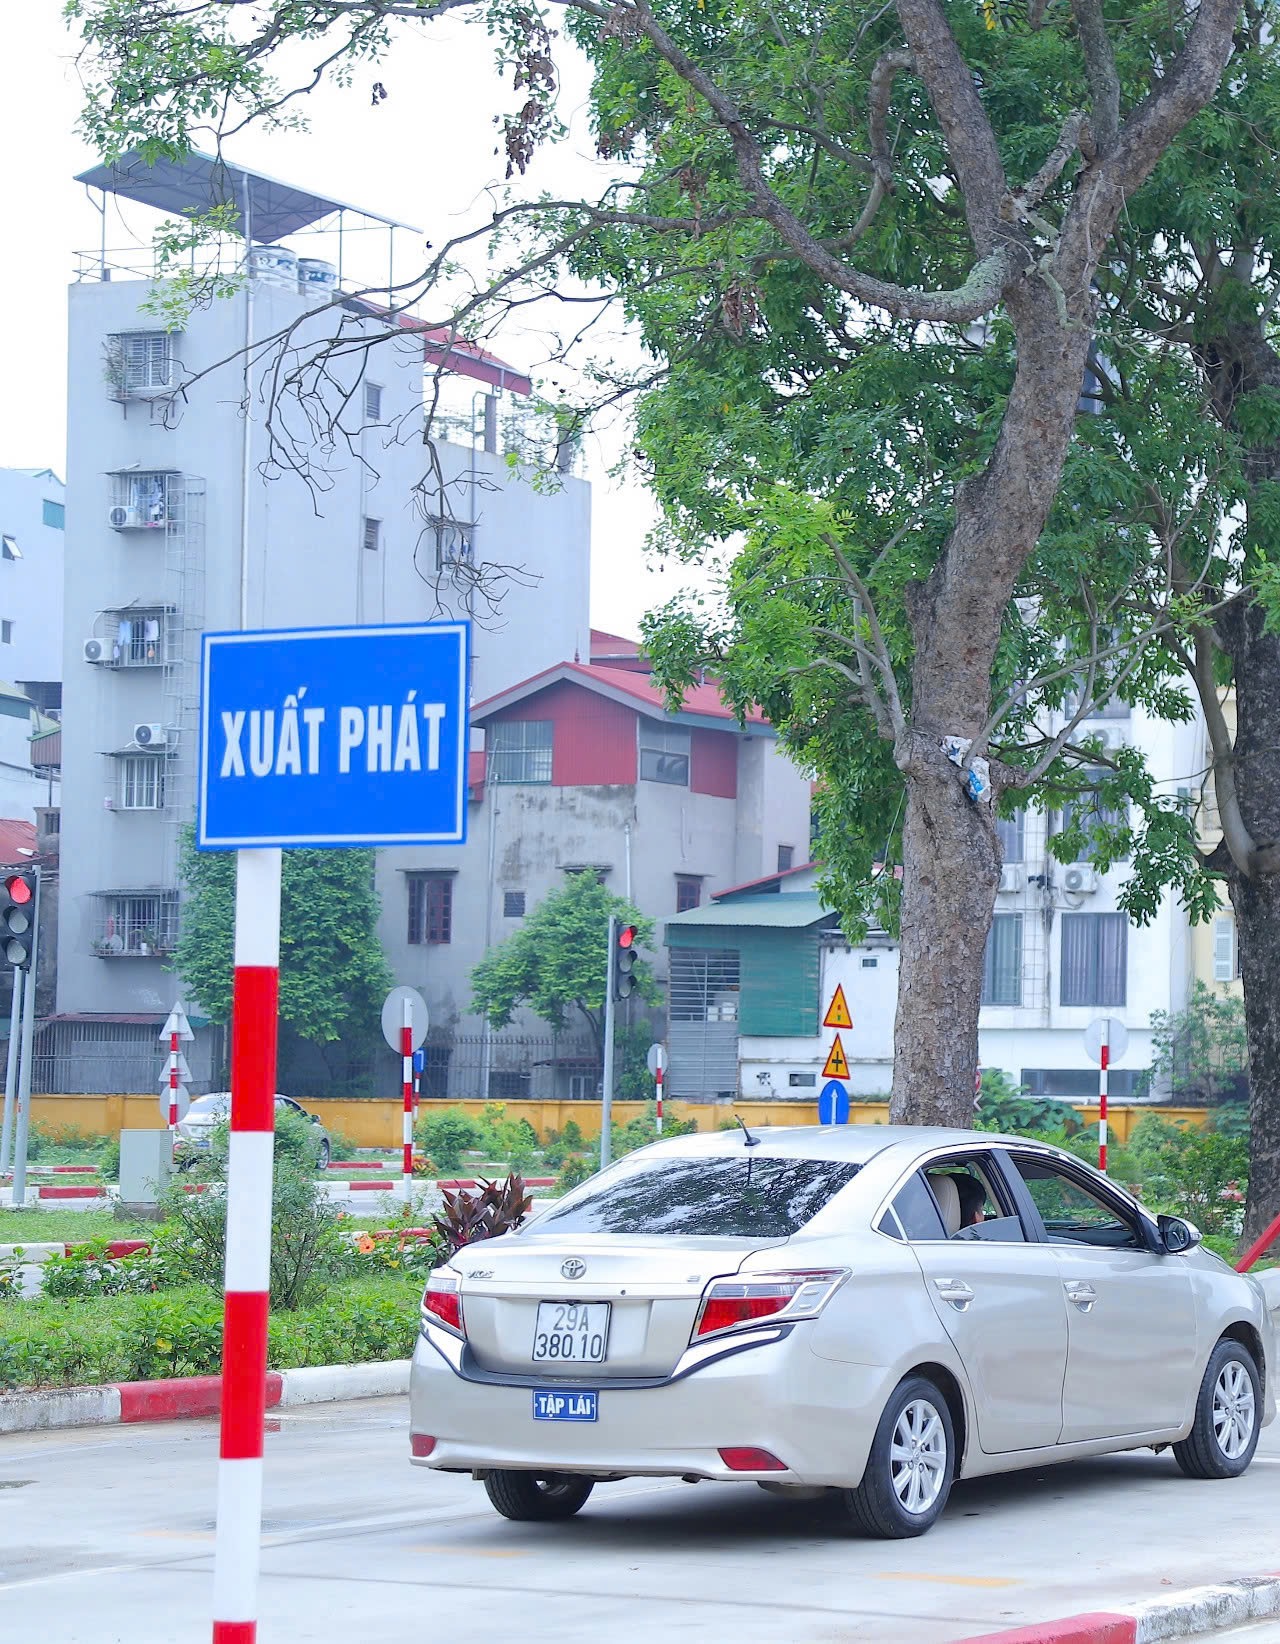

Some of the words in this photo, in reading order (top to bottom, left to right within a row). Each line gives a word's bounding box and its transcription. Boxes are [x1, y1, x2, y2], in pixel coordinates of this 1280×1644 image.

[220, 686, 325, 777] XUẤT
[339, 690, 446, 773] PHÁT
[553, 1306, 589, 1331] 29A
[536, 1333, 602, 1358] 380.10
[539, 1394, 565, 1417] TẬP
[568, 1395, 591, 1415] LÁI
